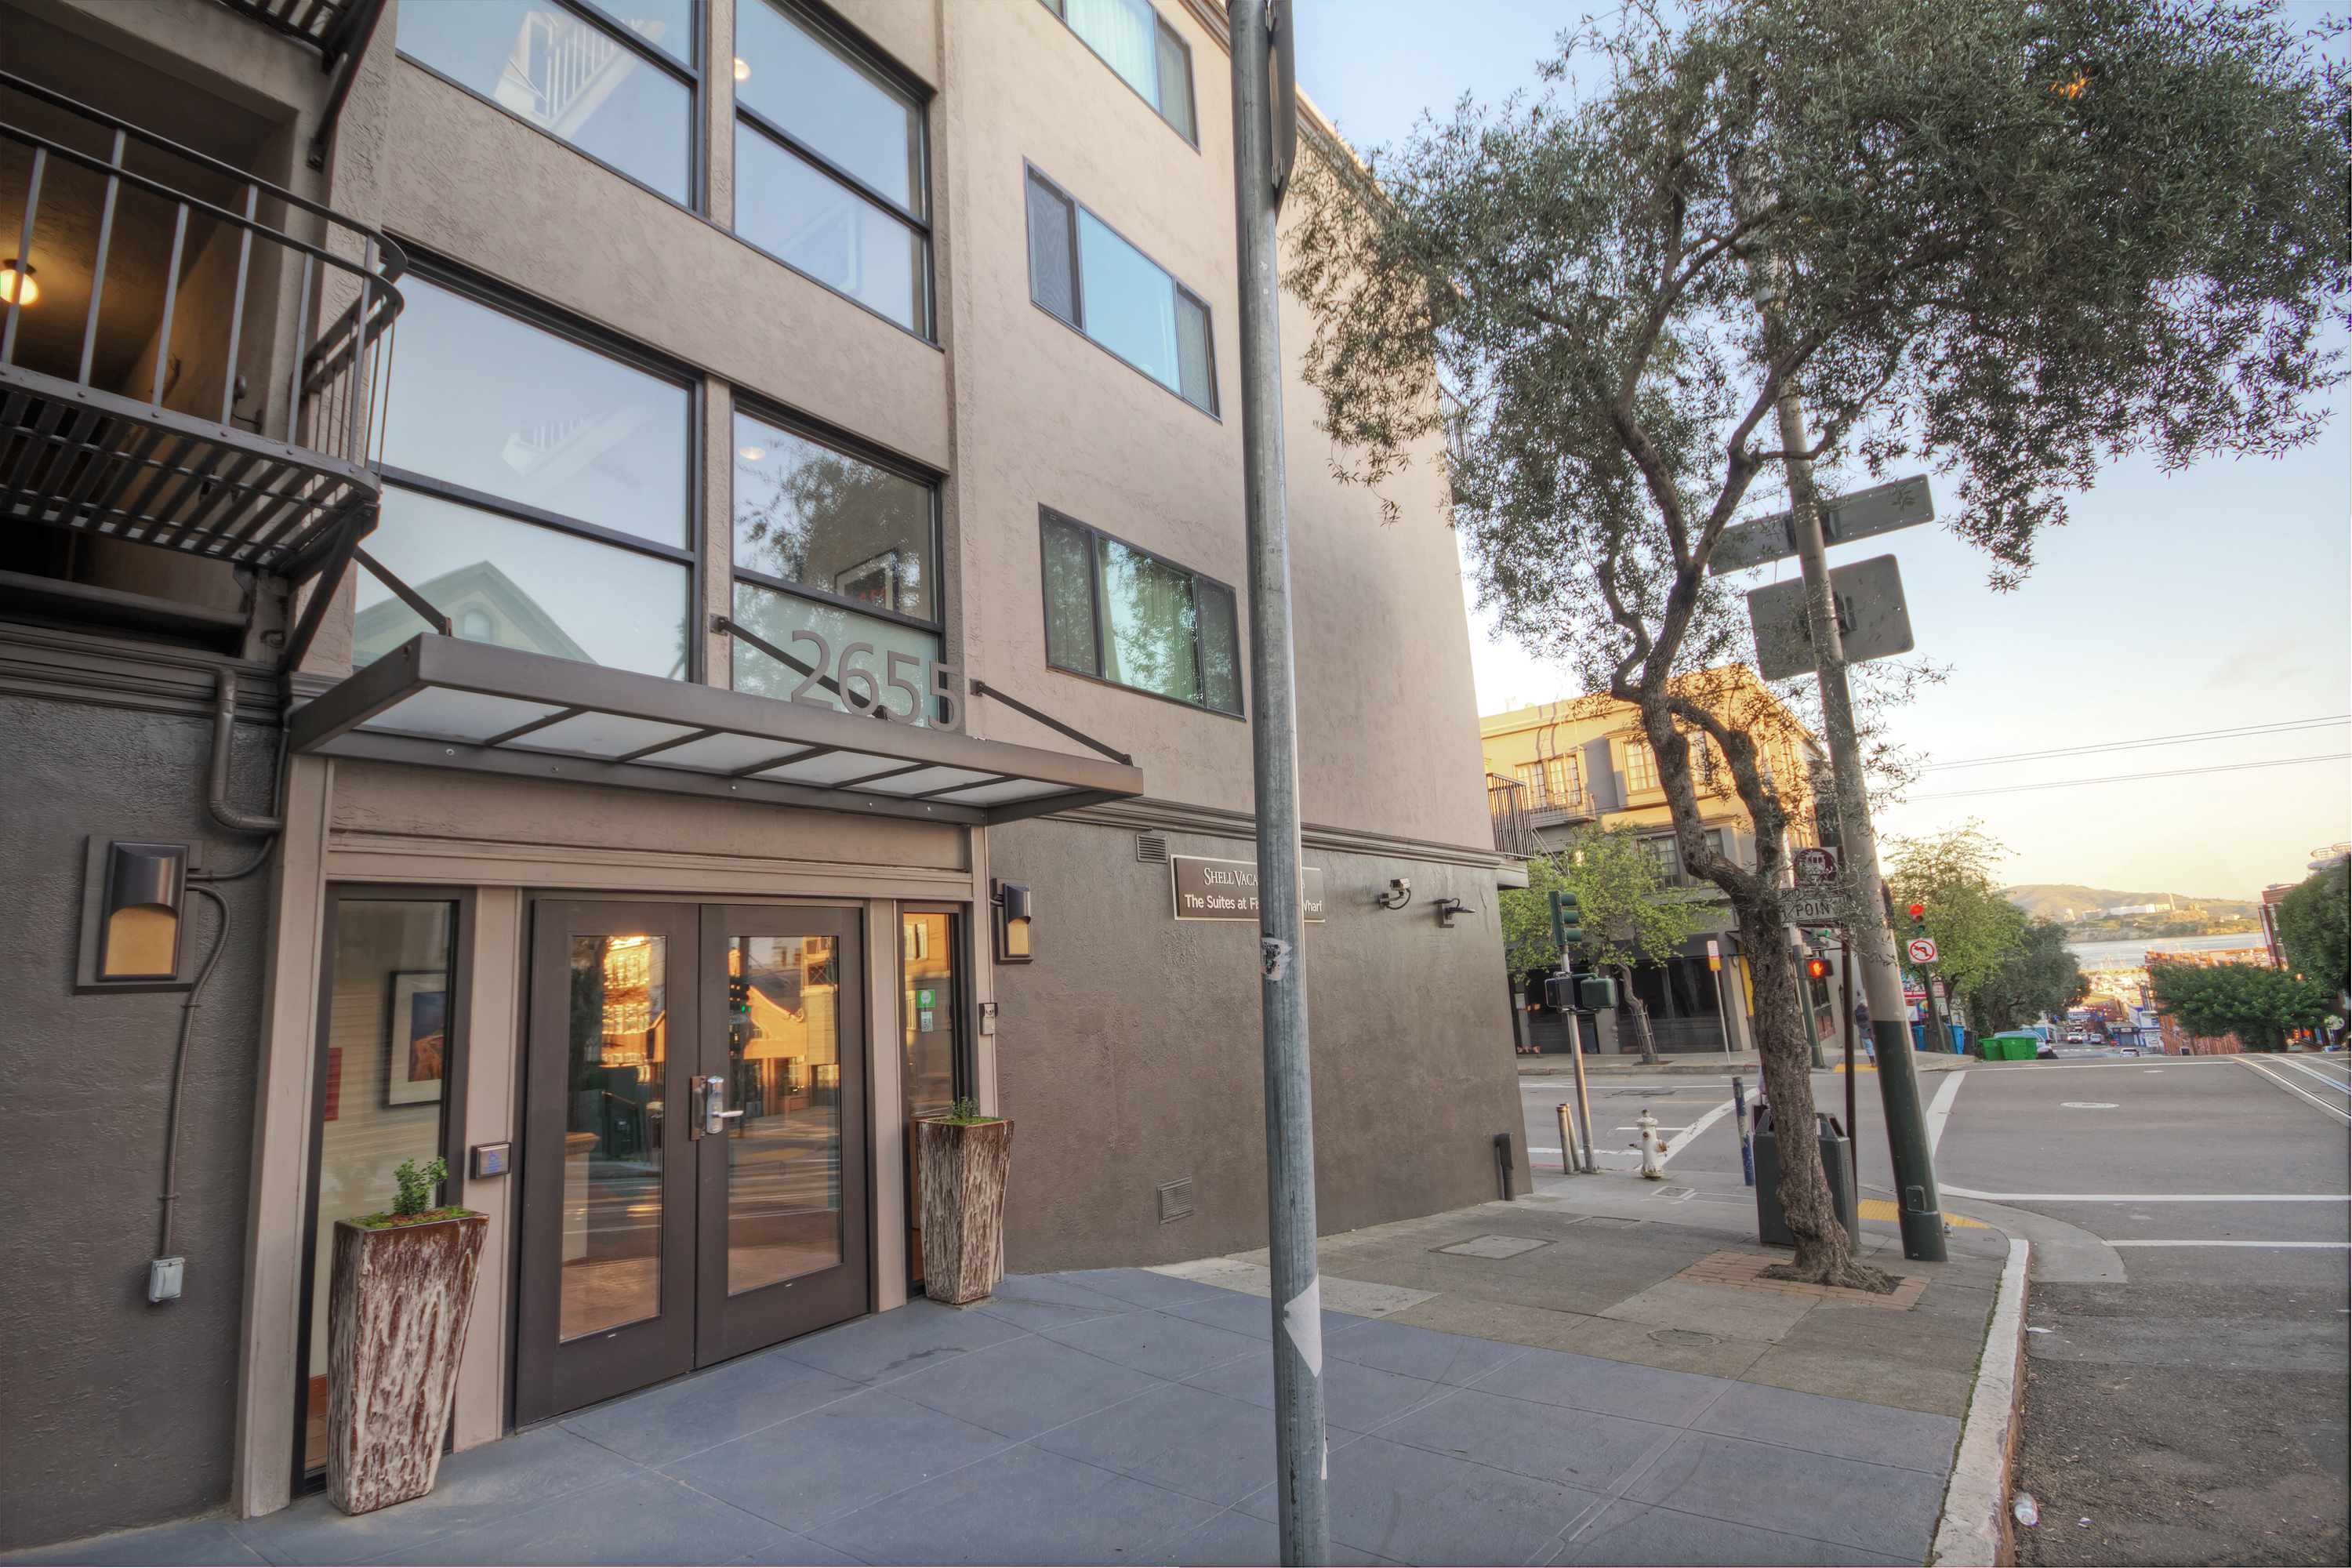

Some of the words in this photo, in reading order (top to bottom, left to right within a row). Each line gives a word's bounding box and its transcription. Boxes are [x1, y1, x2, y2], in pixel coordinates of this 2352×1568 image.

[791, 630, 962, 732] 2655
[1203, 867, 1234, 886] SHELL
[1185, 894, 1204, 909] The
[1206, 895, 1236, 910] Suites
[1238, 898, 1247, 910] at
[1795, 902, 1831, 916] POIN
